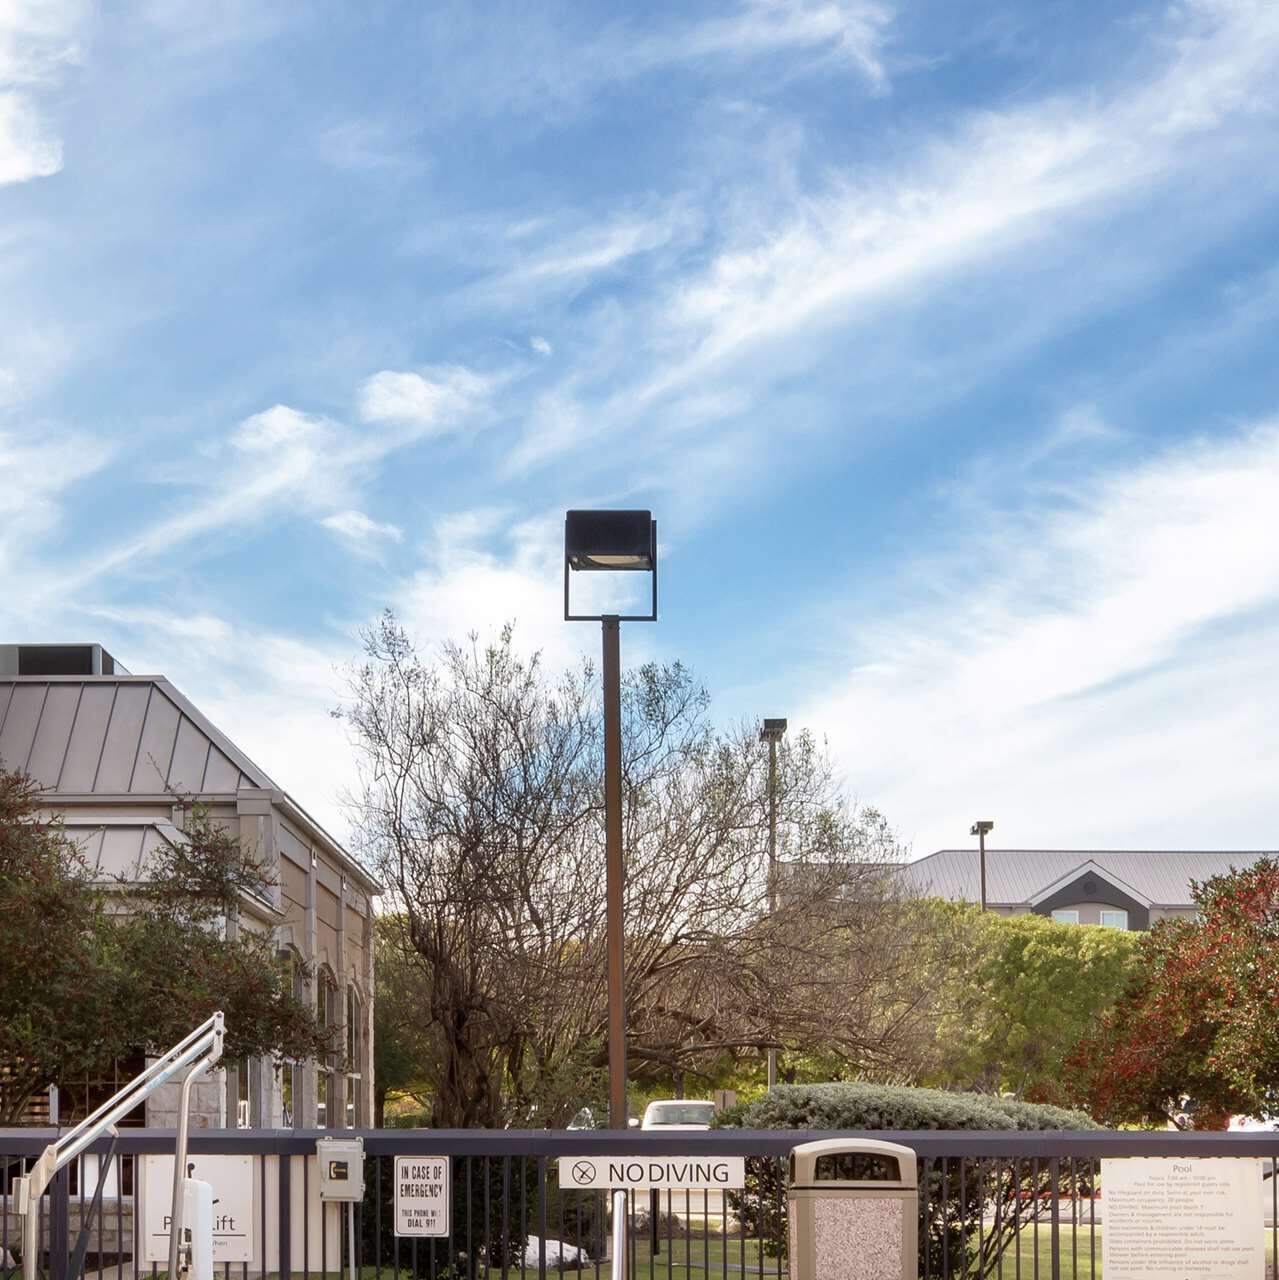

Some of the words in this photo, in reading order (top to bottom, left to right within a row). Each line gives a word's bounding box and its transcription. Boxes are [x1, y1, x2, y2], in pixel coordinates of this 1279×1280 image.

[401, 1166, 409, 1179] IN
[412, 1166, 430, 1180] CASE
[433, 1166, 442, 1180] OF
[609, 1163, 644, 1182] NO
[649, 1163, 729, 1182] DIVING
[1173, 1164, 1192, 1173] Pool
[400, 1184, 442, 1197] EMERGENCY
[212, 1215, 236, 1231] ift
[407, 1219, 423, 1228] DIAL
[426, 1219, 435, 1228] 911
